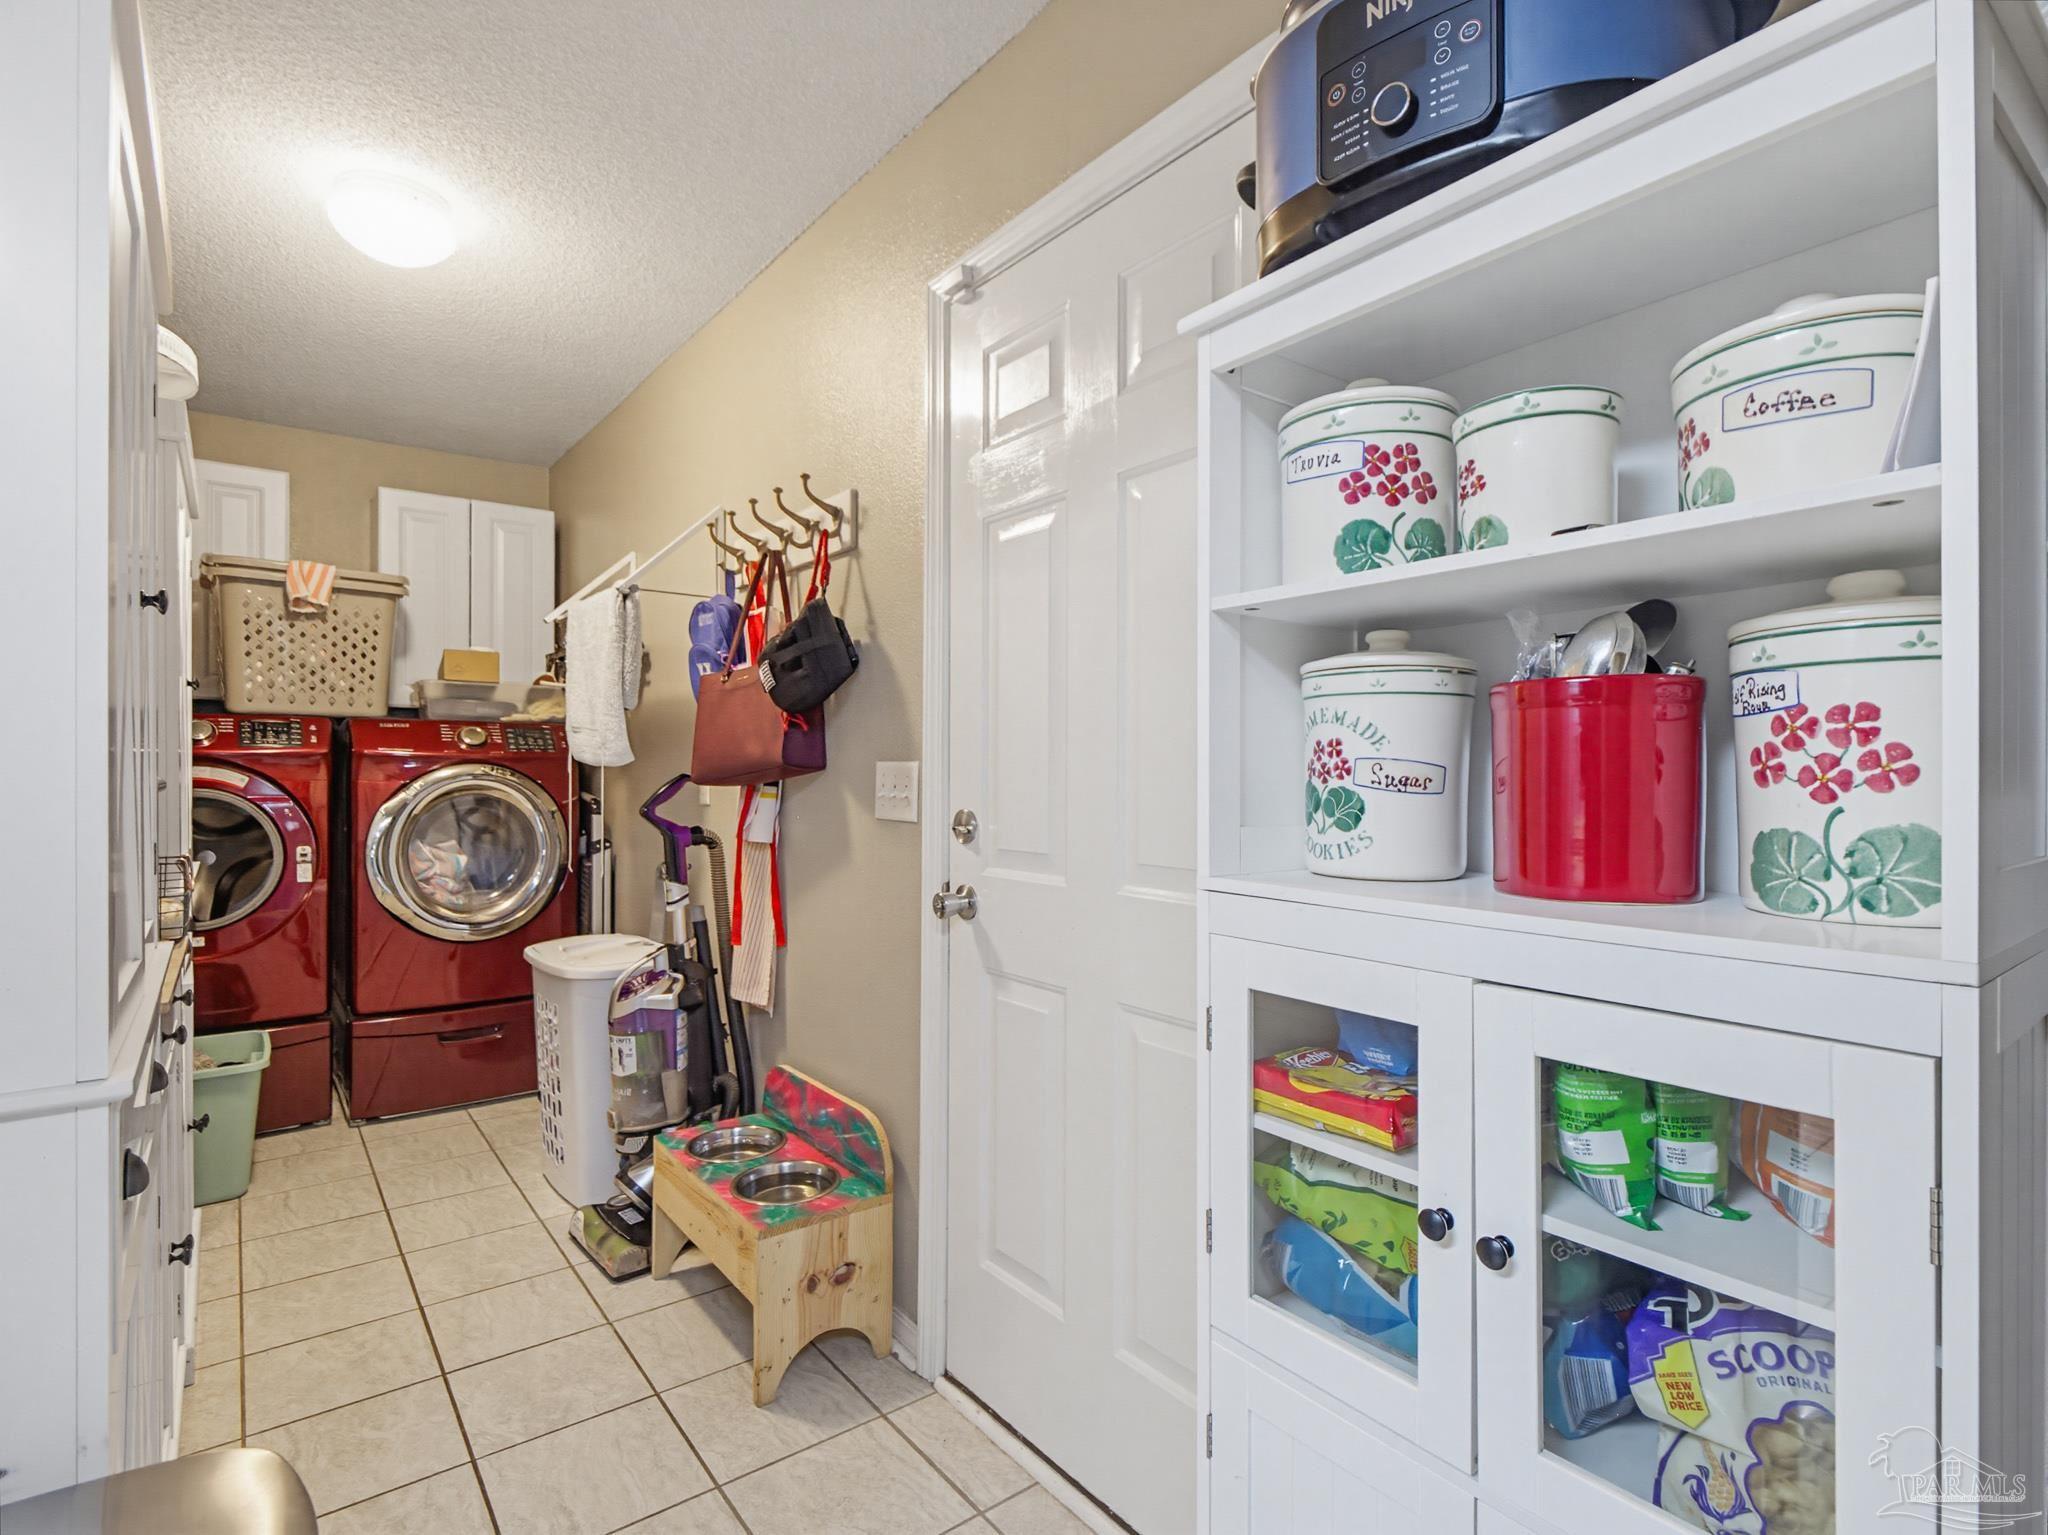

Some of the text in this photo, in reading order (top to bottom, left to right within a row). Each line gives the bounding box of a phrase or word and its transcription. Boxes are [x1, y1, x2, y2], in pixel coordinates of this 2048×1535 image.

[1743, 389, 1837, 418] Coffee
[1745, 677, 1786, 701] Rising
[1305, 707, 1391, 752] MEMADE
[1370, 762, 1433, 792] Sugar
[1305, 830, 1374, 861] OOKIES
[1665, 1381, 1692, 1391] NEW
[1670, 1391, 1695, 1401] LOW
[1756, 1375, 1833, 1395] ORIGINAL
[1669, 1400, 1705, 1411] PRICE
